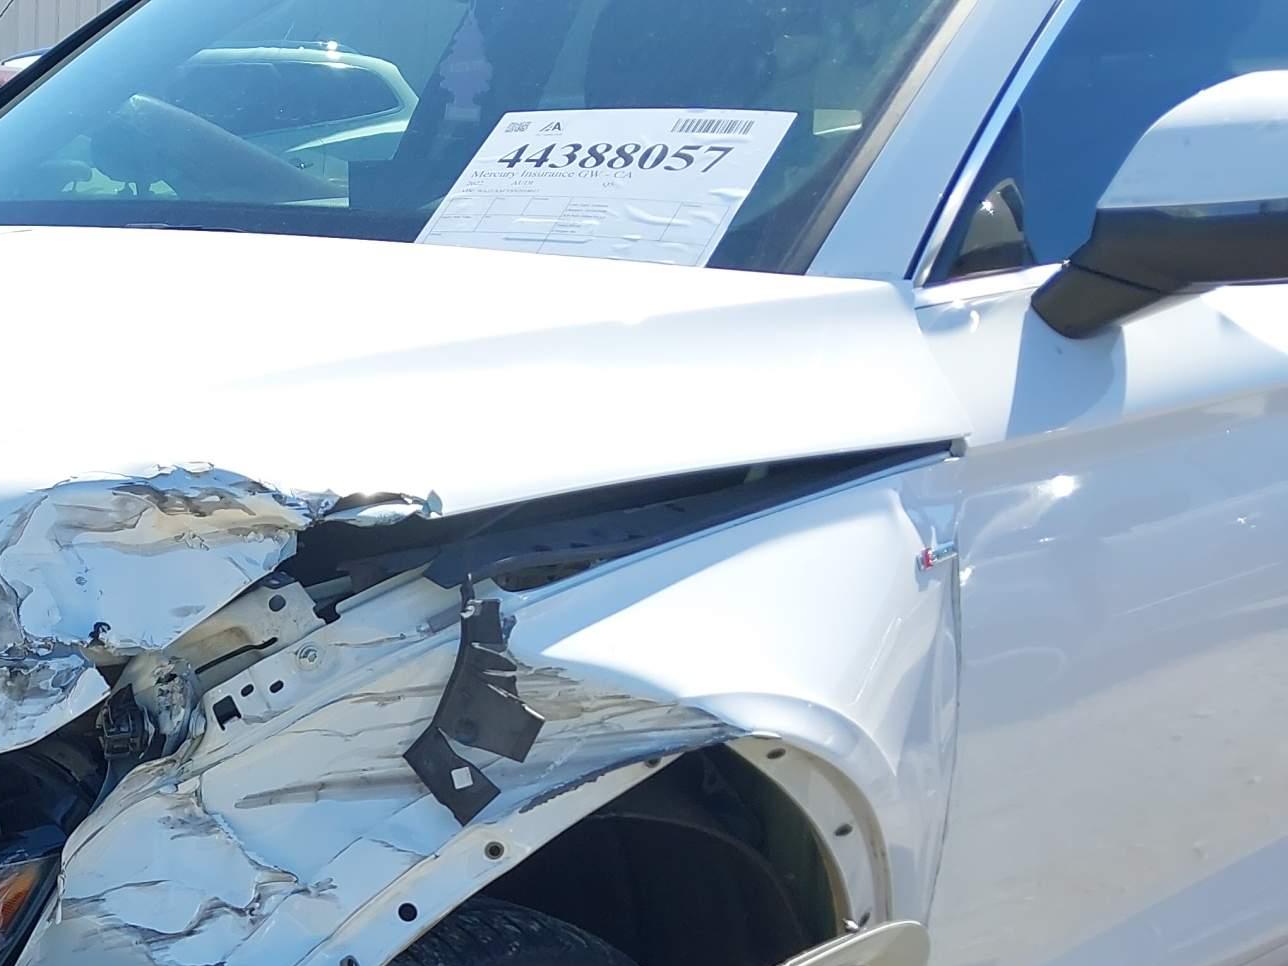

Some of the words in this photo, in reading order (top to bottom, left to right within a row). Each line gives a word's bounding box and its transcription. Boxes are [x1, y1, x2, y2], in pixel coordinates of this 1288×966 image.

[497, 142, 734, 173] 44388057
[471, 170, 516, 179] Mercury
[520, 169, 576, 178] Insurance
[578, 170, 602, 178] GW
[614, 170, 633, 179] CA
